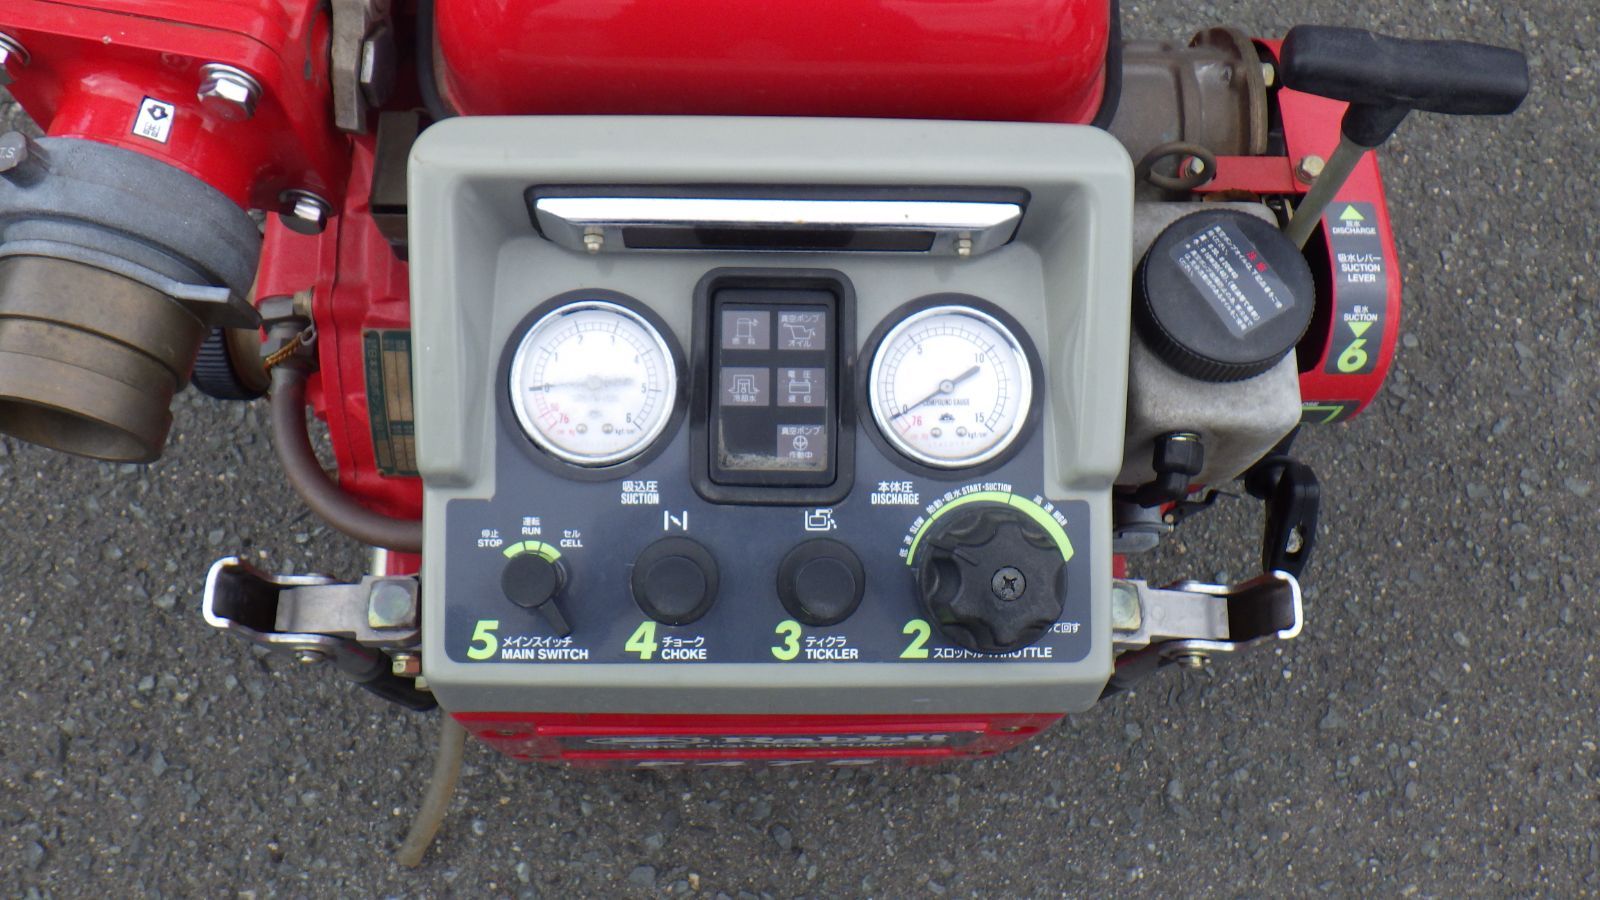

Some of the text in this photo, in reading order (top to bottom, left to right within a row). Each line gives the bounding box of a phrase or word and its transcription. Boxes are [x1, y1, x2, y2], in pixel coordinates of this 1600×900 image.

[1341, 263, 1380, 272] SUCTION
[1348, 273, 1376, 282] LEVER
[1343, 313, 1378, 321] SUCTION
[917, 345, 922, 355] 5
[975, 353, 984, 363] 10
[1337, 339, 1368, 373] 6
[641, 384, 647, 393] 5
[903, 404, 908, 414] 0
[559, 413, 569, 424] 76
[626, 412, 632, 423] 6
[912, 416, 922, 426] 76
[975, 412, 984, 422] 15
[622, 480, 658, 493] 吸込圧
[878, 481, 913, 493] 本体圧
[621, 493, 659, 504] SUCTION
[871, 493, 919, 504] DISCHARGE
[909, 516, 924, 534] SLOW
[481, 529, 499, 538] 停止
[522, 527, 541, 535] RUN
[563, 530, 581, 539] セル
[478, 539, 503, 548] STOP
[560, 539, 583, 548] CELL
[467, 619, 499, 660] 5
[502, 636, 573, 647] メインスイッチ
[625, 621, 658, 660] 4
[662, 636, 704, 648] チョーク
[771, 620, 802, 660] 3
[805, 636, 847, 648] ティクラ
[899, 619, 931, 659] 2
[501, 649, 589, 660] MAIN SWITCH
[661, 649, 707, 660] CHOKE
[805, 649, 858, 659] TICKLER
